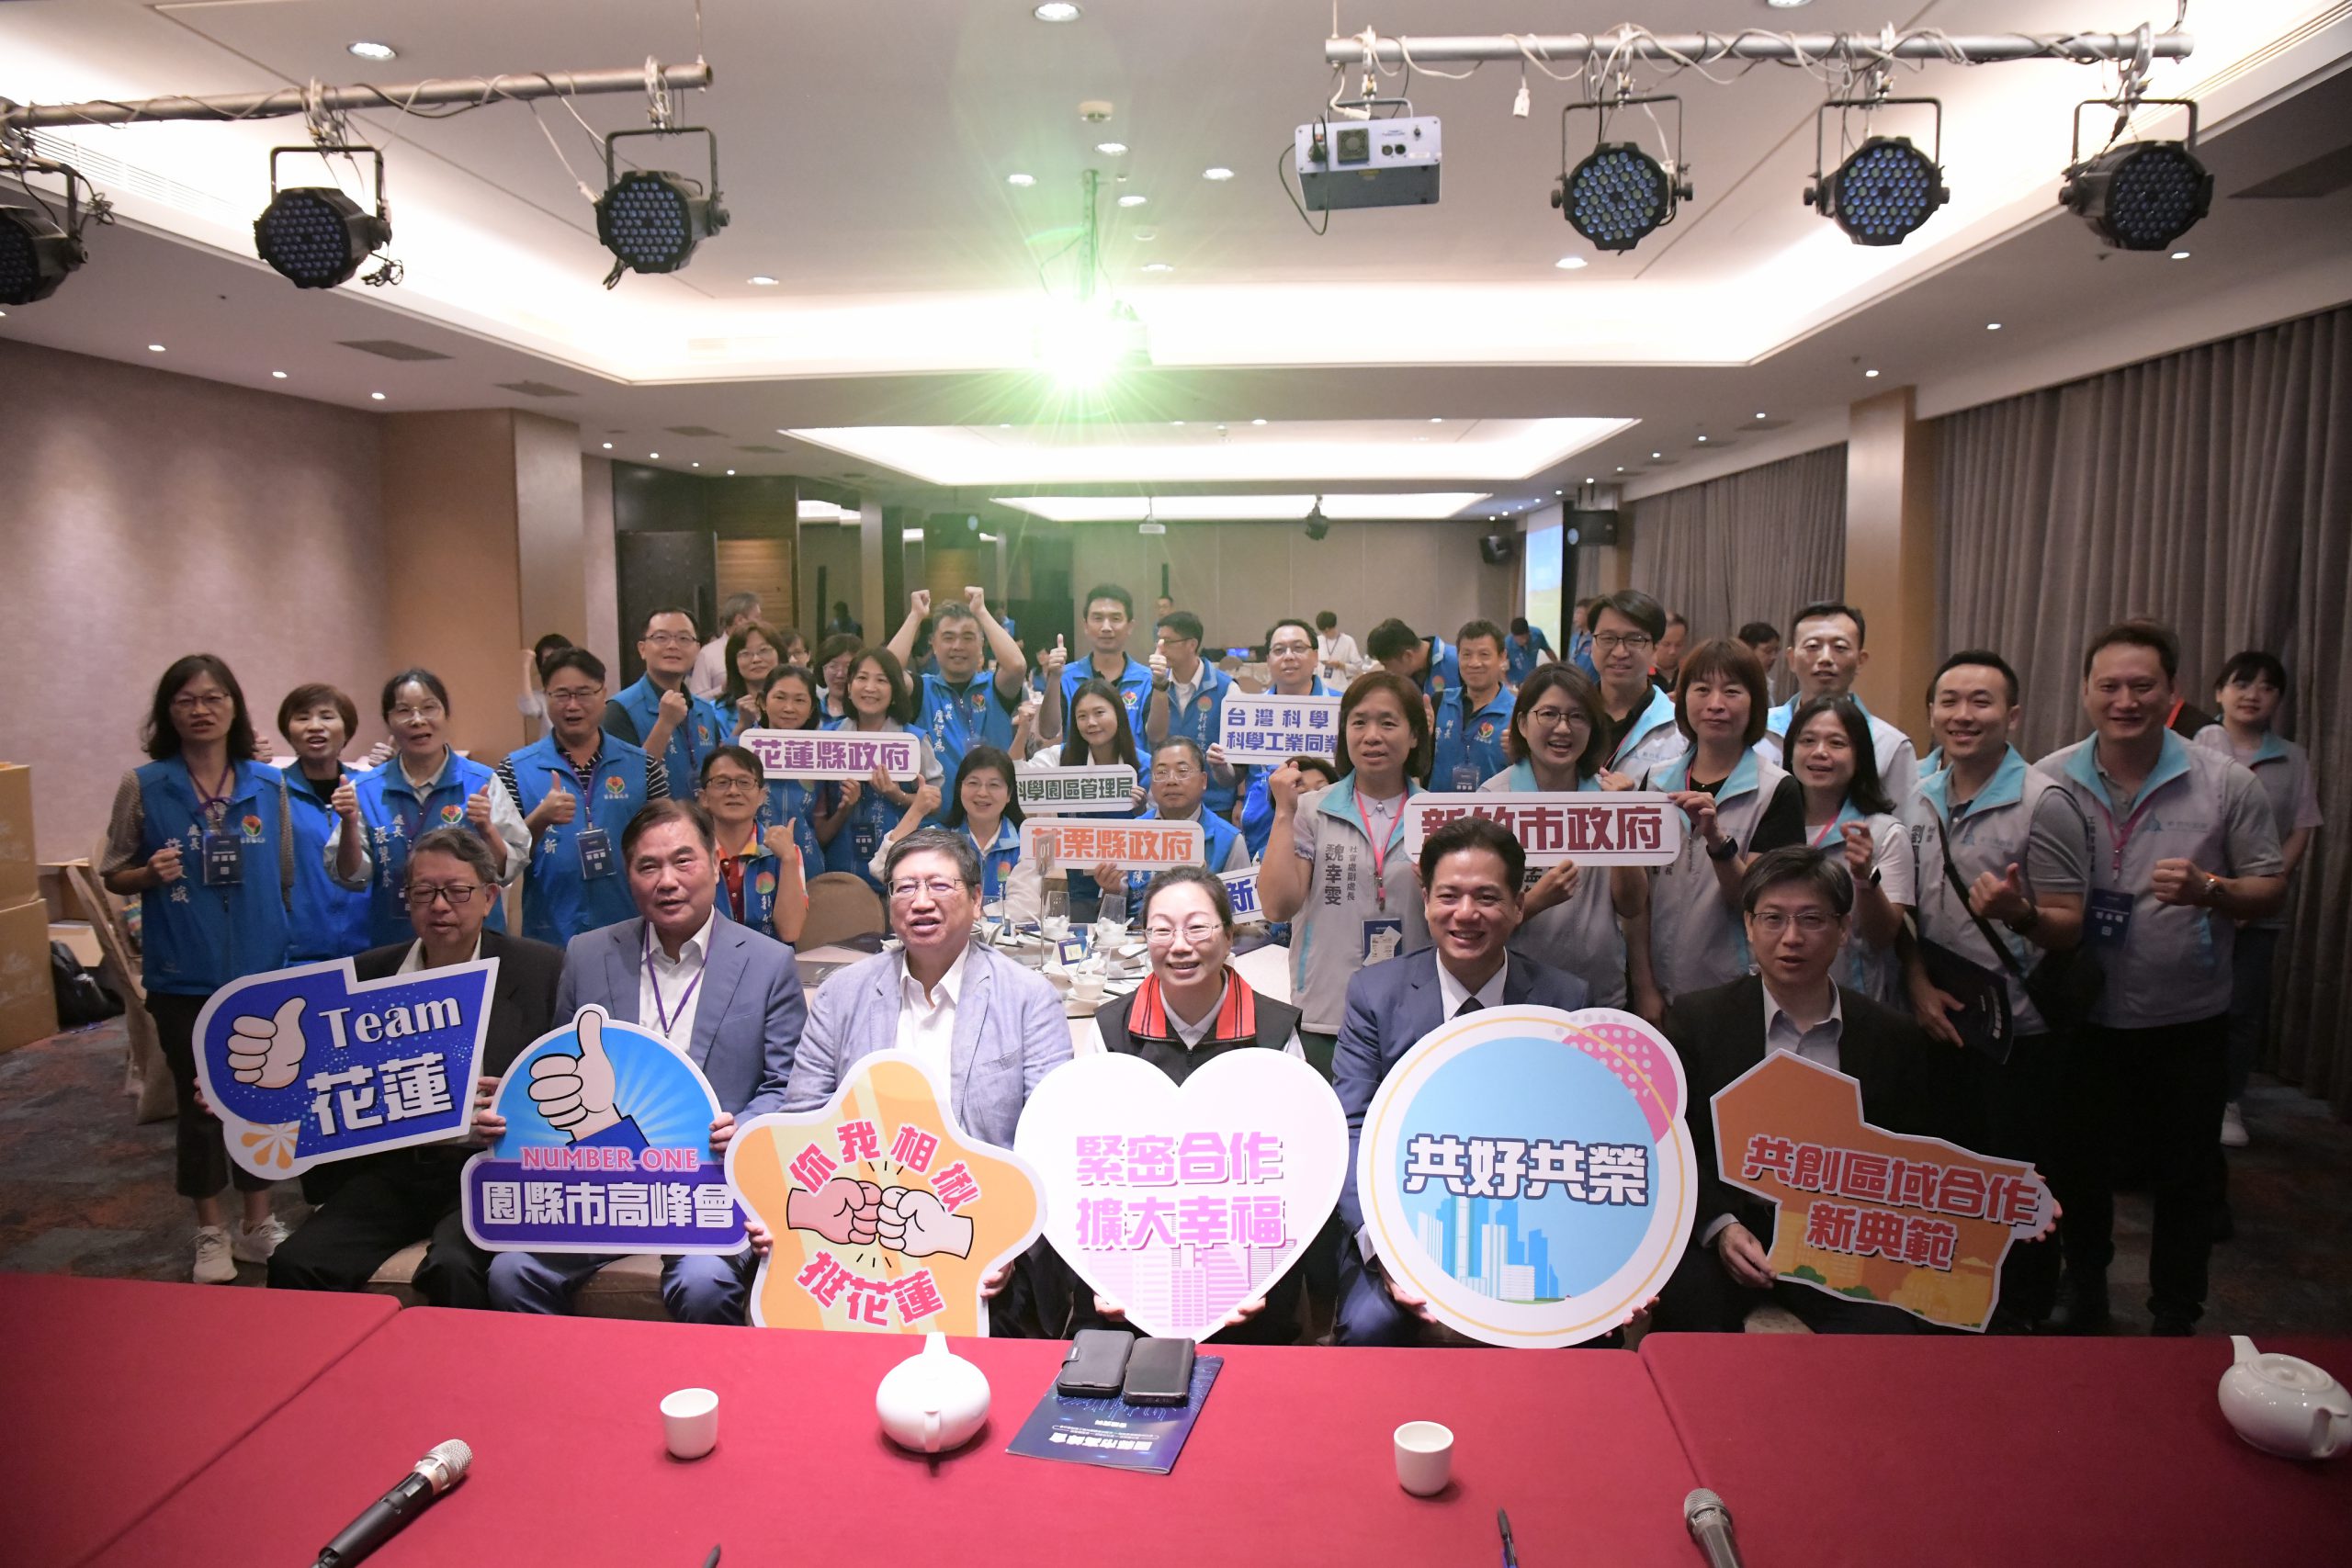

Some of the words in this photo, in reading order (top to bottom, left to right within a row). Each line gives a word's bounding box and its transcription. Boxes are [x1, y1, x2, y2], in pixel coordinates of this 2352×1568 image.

[1227, 708, 1341, 729] 台灣科學
[752, 739, 910, 771] 花蓮縣政府
[1040, 842, 1050, 858] 01
[1324, 843, 1345, 906] 魏幸雯
[1225, 878, 1259, 914] 新
[319, 998, 461, 1048] Team
[307, 1053, 453, 1136] 花蓮
[520, 1147, 635, 1170] NUMBER
[640, 1148, 700, 1170] ONE
[1076, 1131, 1283, 1187] 緊密合作
[1405, 1135, 1647, 1206] 共好共榮
[1745, 1135, 2039, 1225] 共創區域合作
[482, 1181, 736, 1228] 園縣市高峰會
[1076, 1195, 1286, 1250] 擴大幸福
[1806, 1202, 1956, 1269] 新典範
[797, 1251, 944, 1326] 挺花蓮
